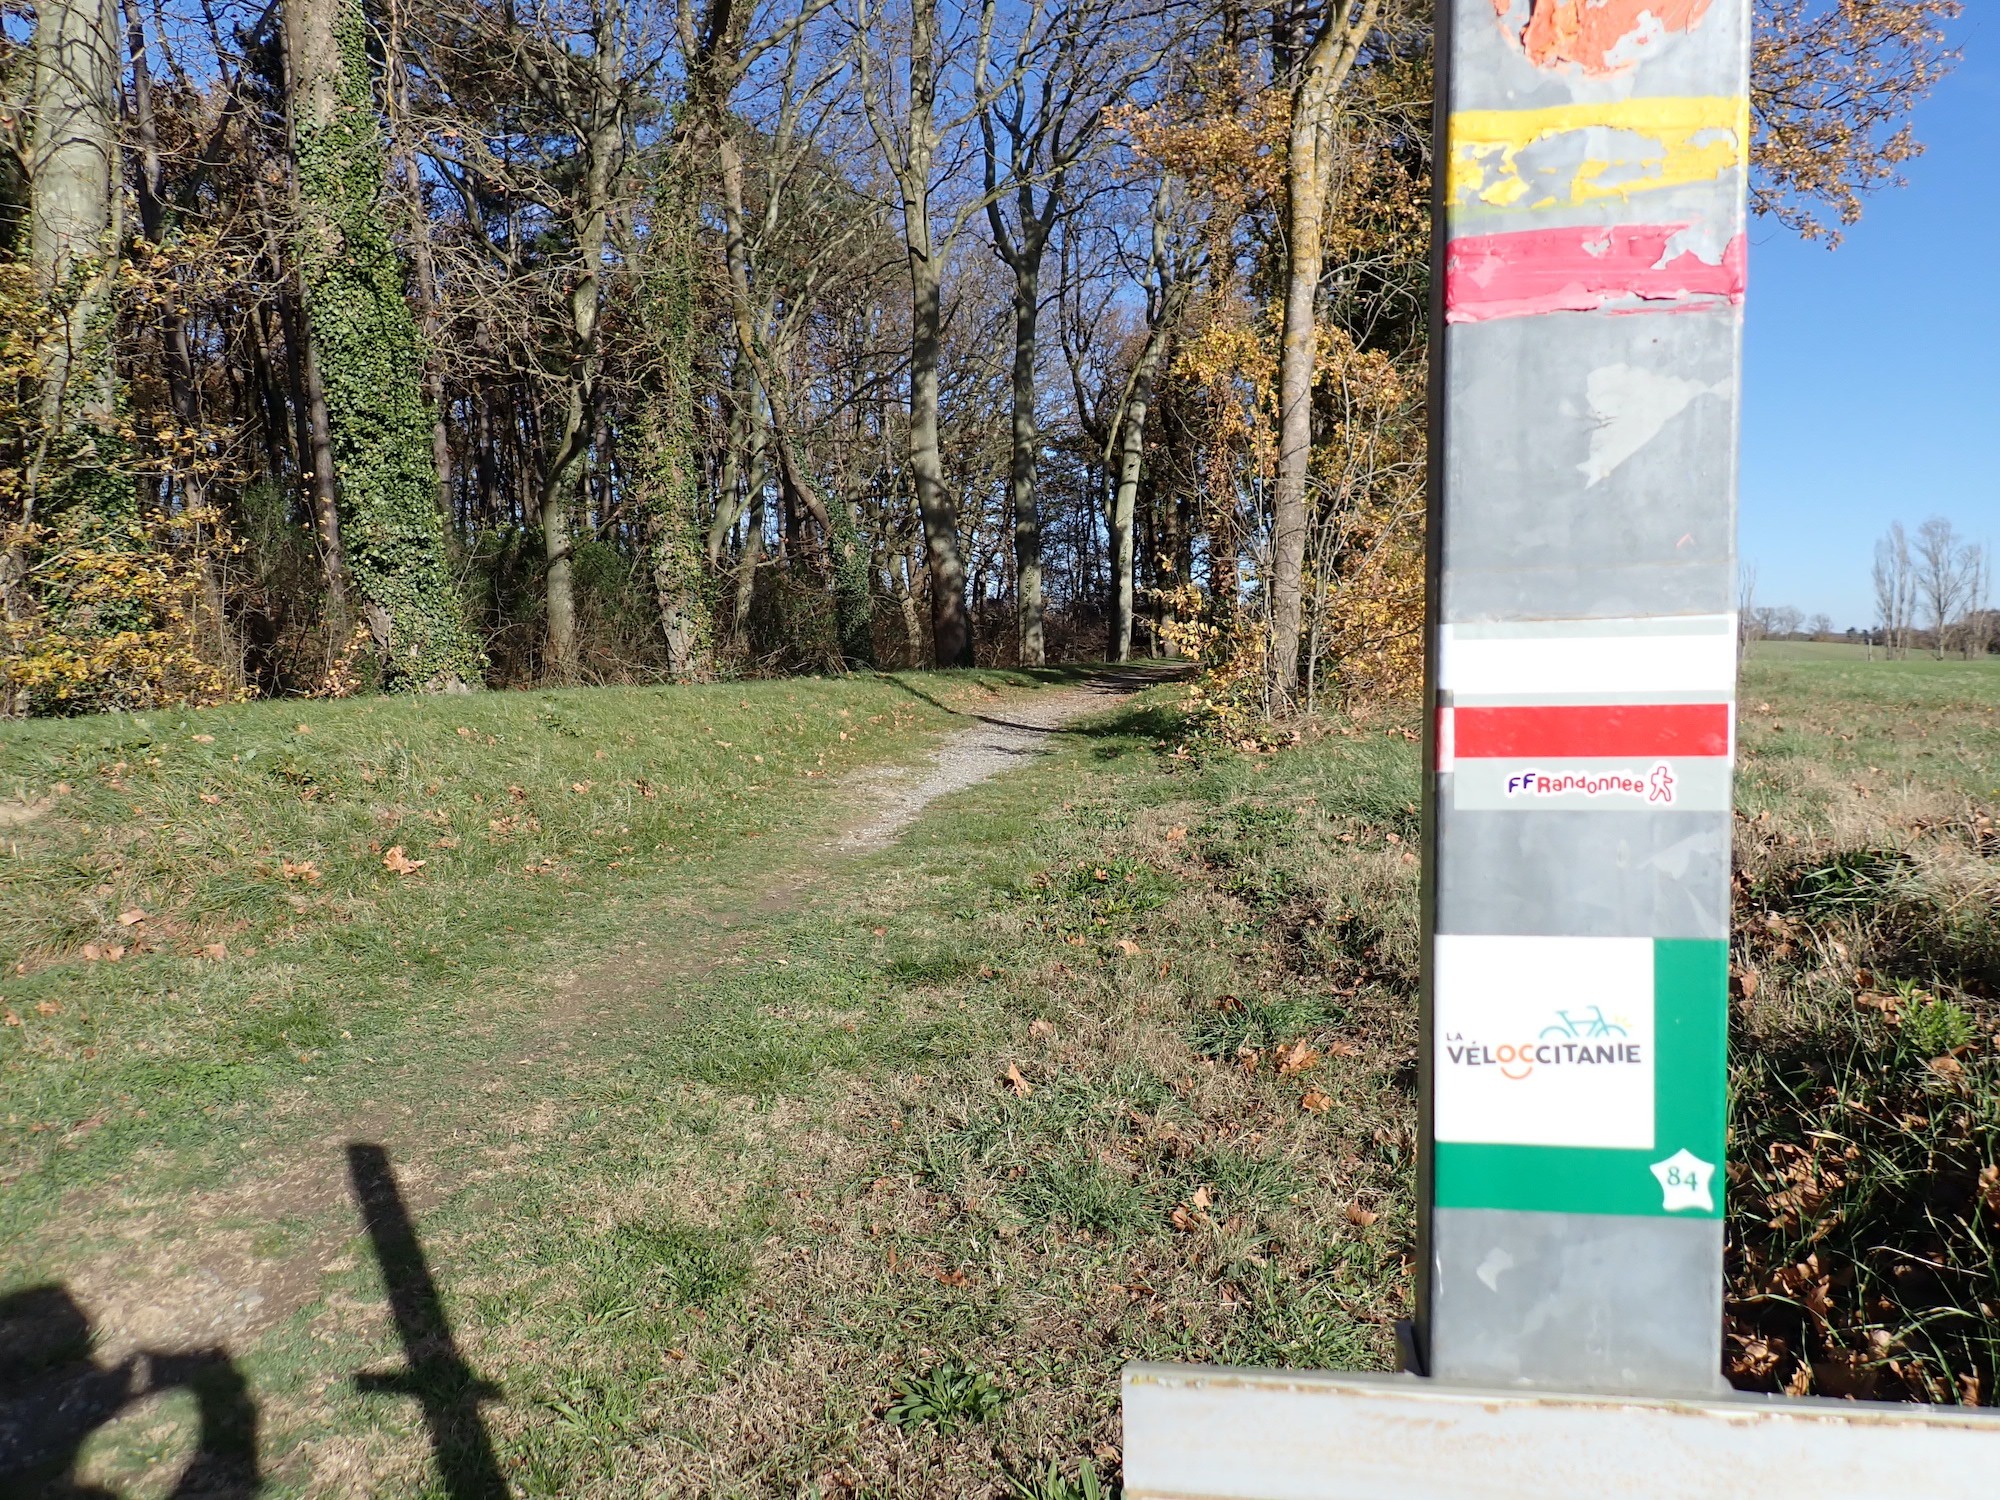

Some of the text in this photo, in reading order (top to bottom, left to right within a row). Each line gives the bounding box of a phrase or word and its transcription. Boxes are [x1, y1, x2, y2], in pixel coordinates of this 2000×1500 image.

[1446, 1032, 1463, 1042] LA
[1446, 1041, 1642, 1066] VÉLOCCITANIE
[1667, 1166, 1698, 1191] 84
